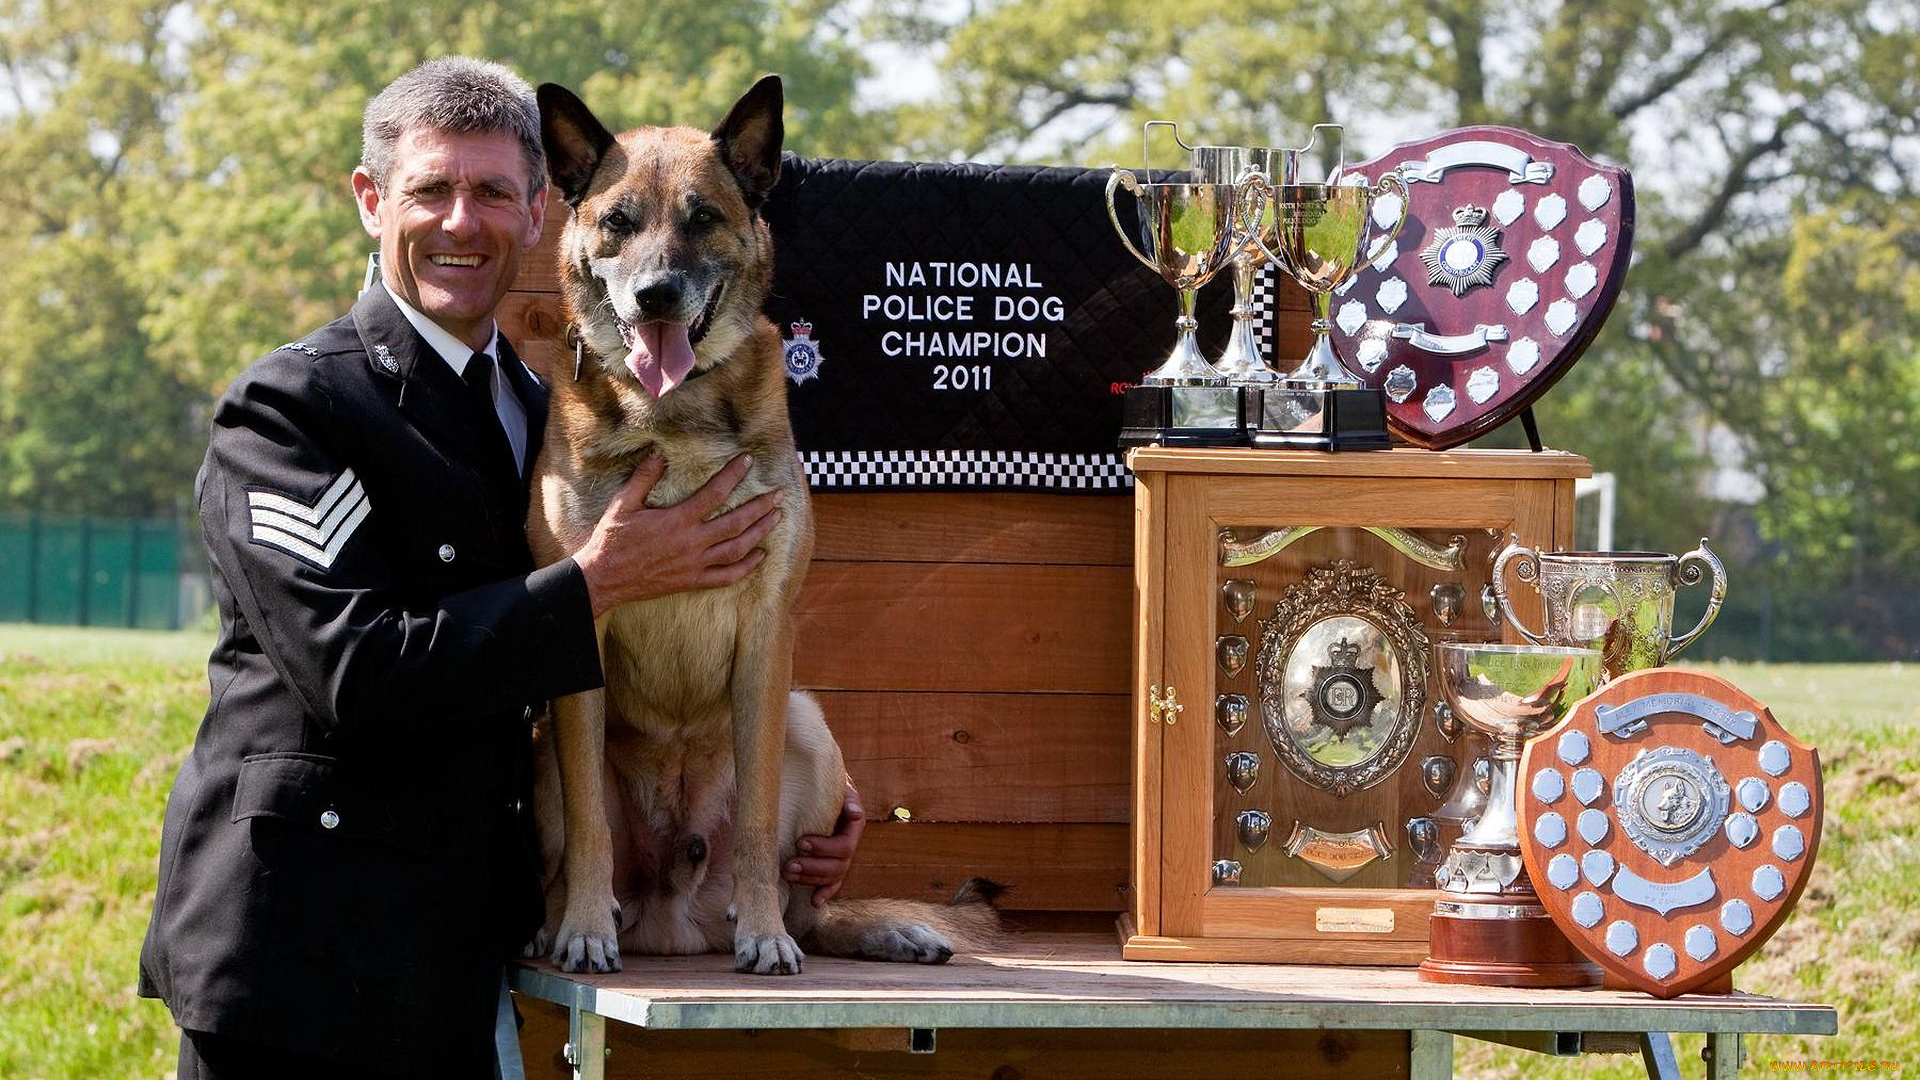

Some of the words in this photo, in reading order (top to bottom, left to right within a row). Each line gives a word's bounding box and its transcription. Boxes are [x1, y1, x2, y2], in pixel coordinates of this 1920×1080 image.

[886, 261, 1042, 288] NATIONAL
[863, 294, 974, 321] POLICE
[994, 295, 1064, 321] DOG
[881, 331, 1046, 358] CHAMPION
[933, 365, 991, 391] 2011
